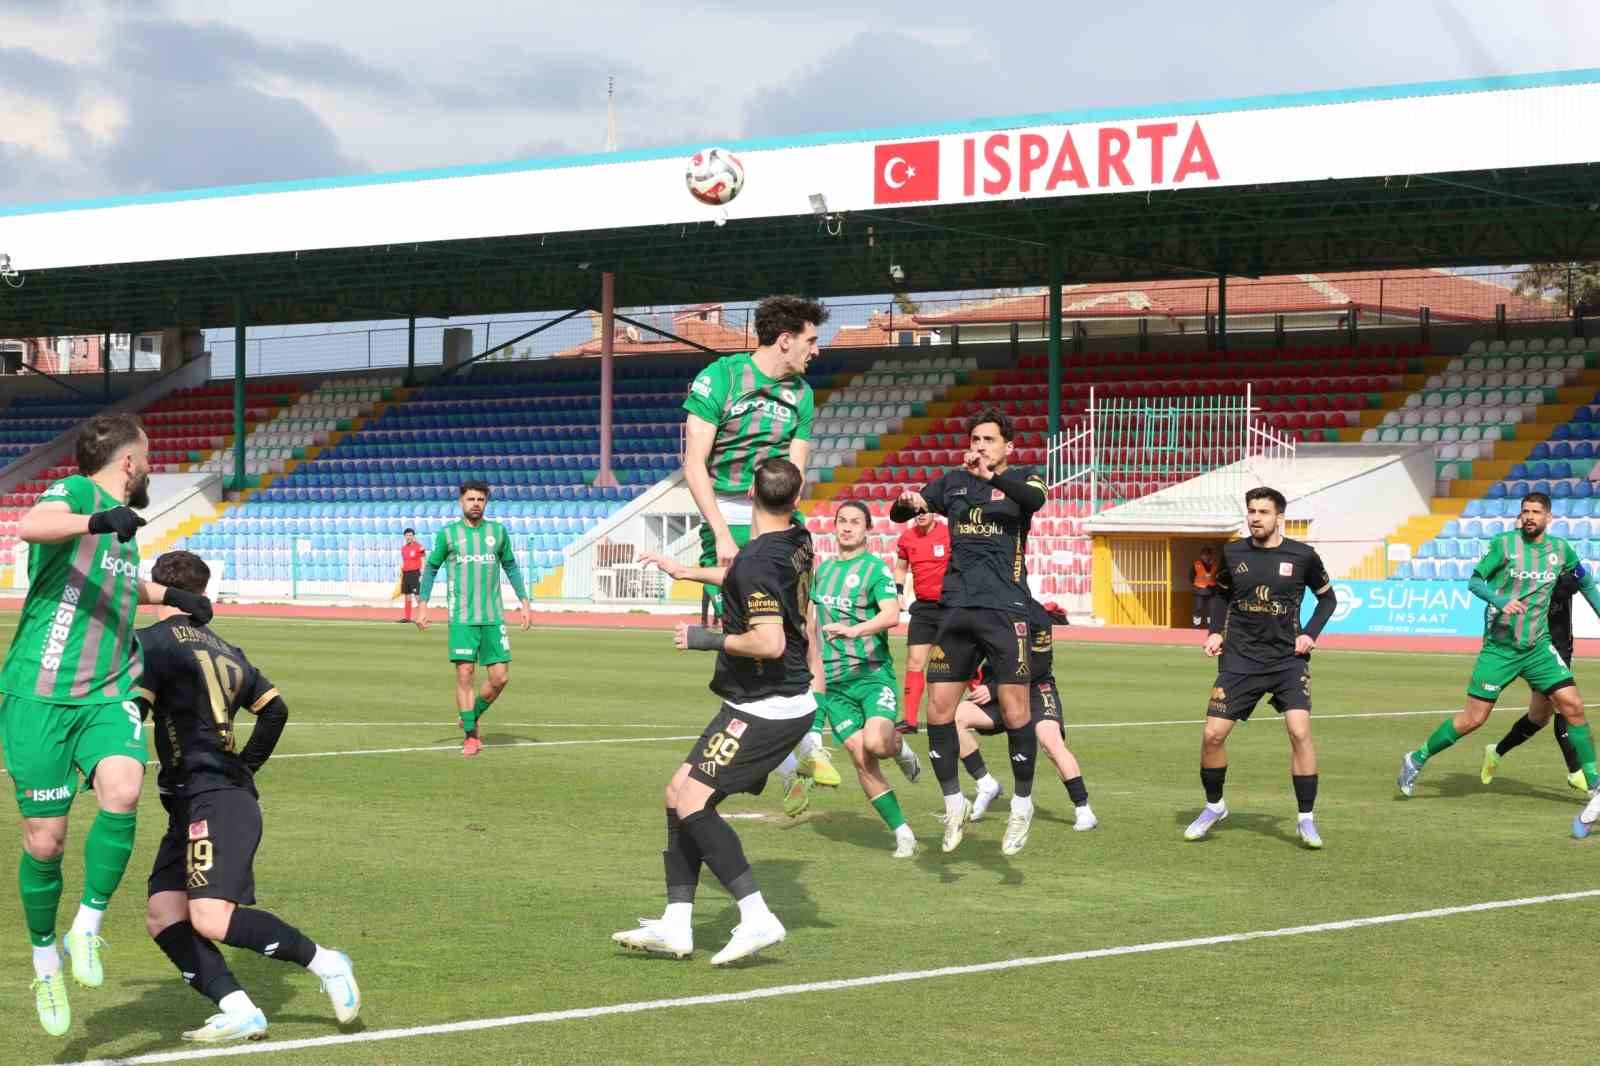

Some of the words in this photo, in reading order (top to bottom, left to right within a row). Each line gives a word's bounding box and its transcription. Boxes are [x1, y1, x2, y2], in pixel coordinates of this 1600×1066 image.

[962, 119, 1220, 196] ISPARTA
[1367, 583, 1473, 610] SÜHAN
[703, 732, 740, 766] 99
[186, 839, 214, 873] 19
